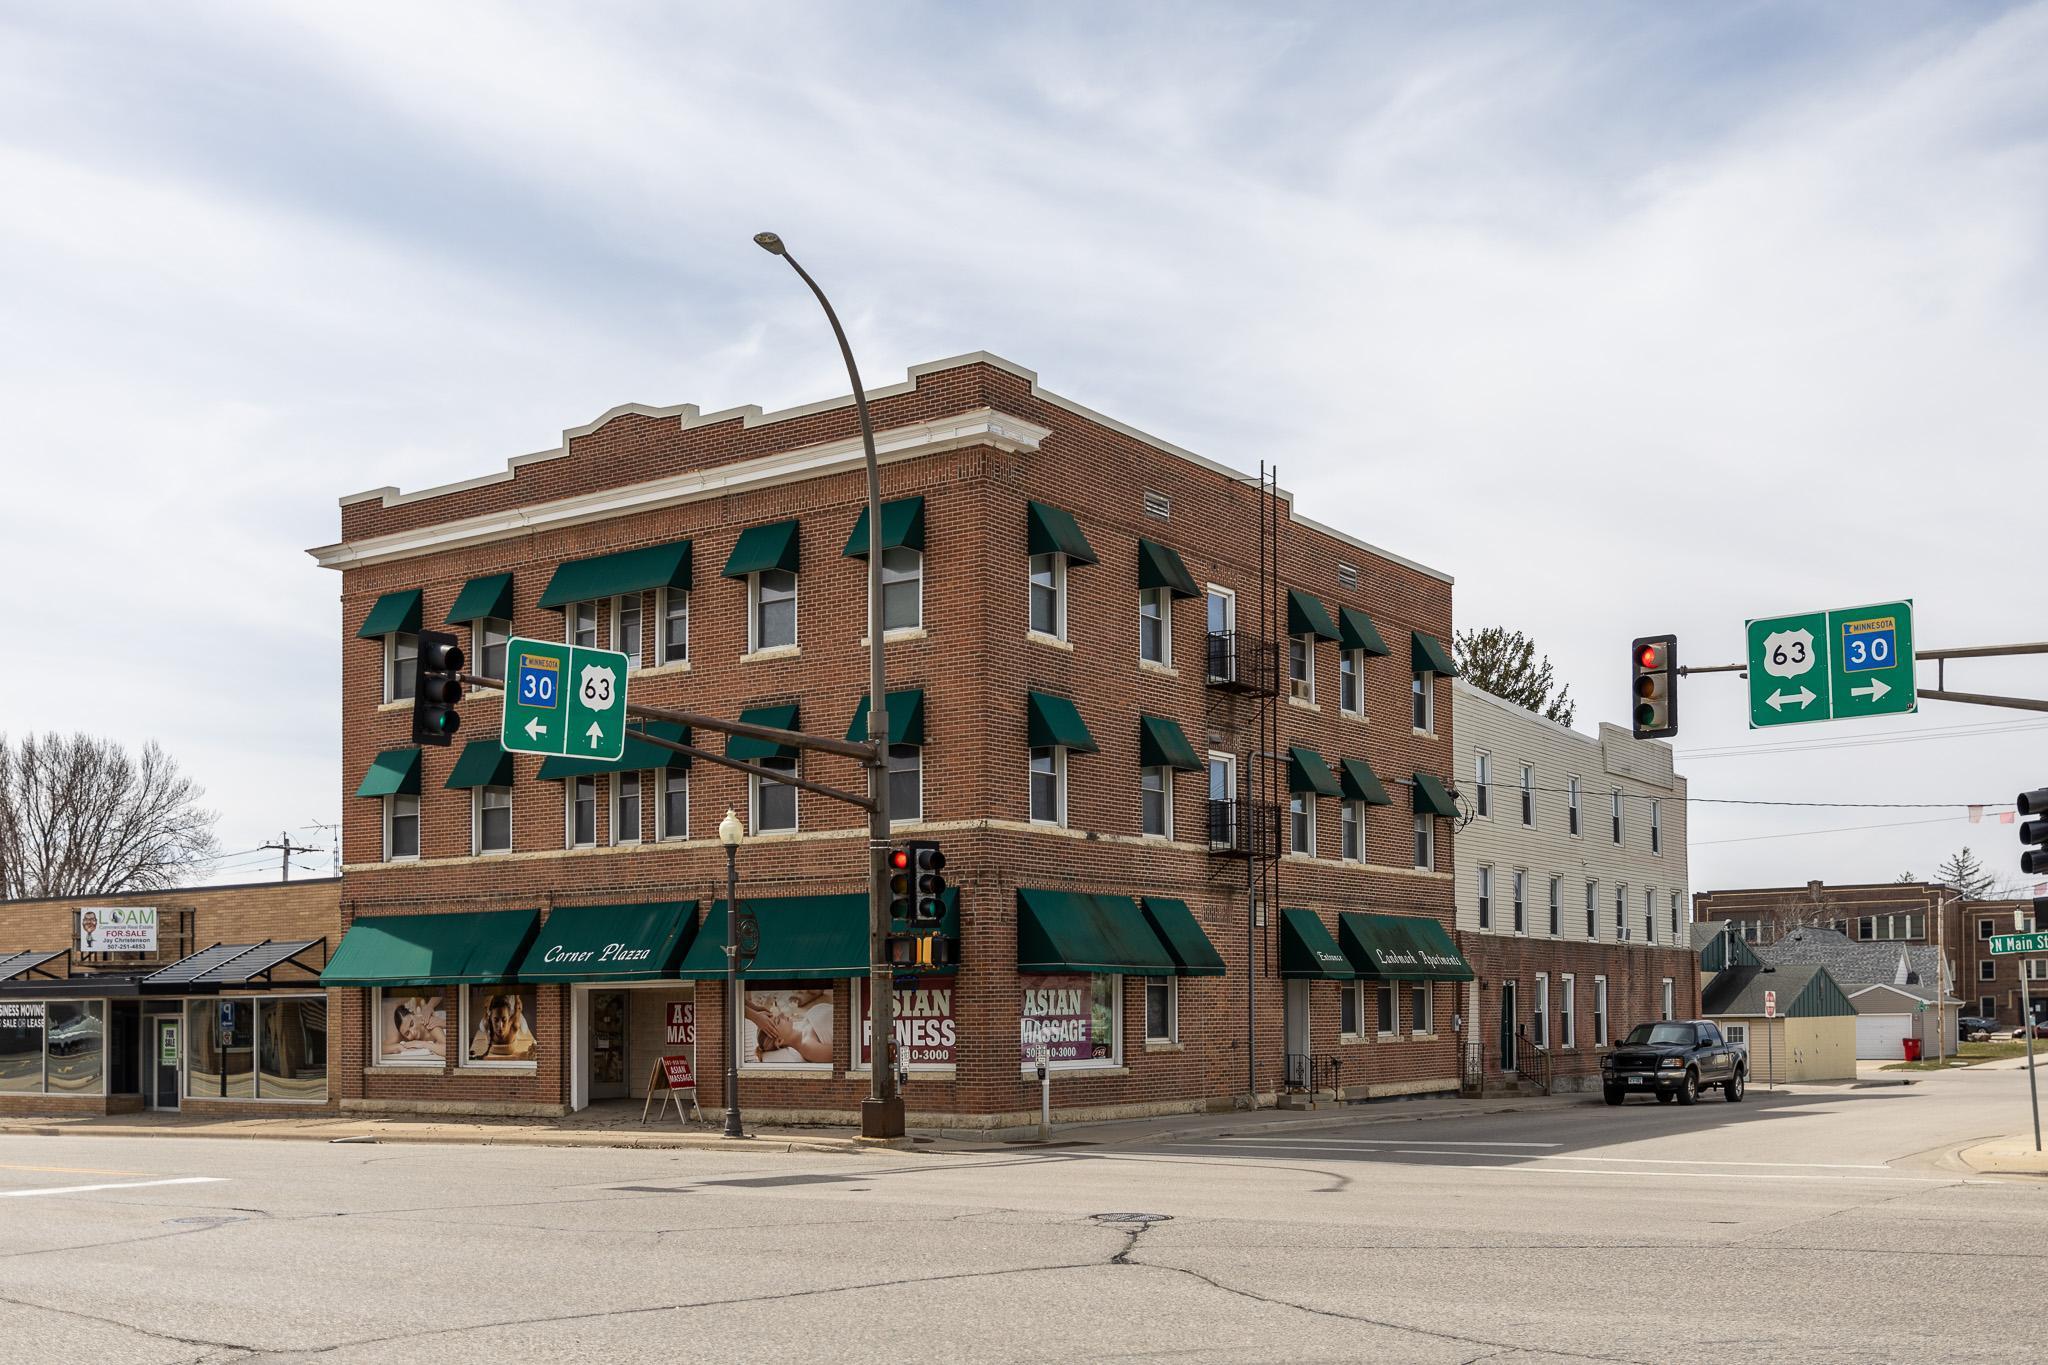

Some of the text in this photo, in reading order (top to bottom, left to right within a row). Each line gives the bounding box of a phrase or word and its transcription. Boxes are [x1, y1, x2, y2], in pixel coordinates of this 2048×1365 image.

[1853, 620, 1894, 632] MINNESOTA
[1772, 642, 1805, 665] 63
[1850, 638, 1888, 664] 30
[524, 674, 552, 700] 30
[585, 678, 610, 701] 63
[544, 943, 651, 963] Corner Plazza
[1995, 935, 2048, 952] N Main St
[20, 1004, 45, 1017] MOVING
[867, 989, 951, 1017] SIAN
[1023, 989, 1082, 1016] ASIAN
[2, 1019, 17, 1028] SALE
[863, 1019, 957, 1047] FNESS
[1021, 1019, 1087, 1043] MASSAGE
